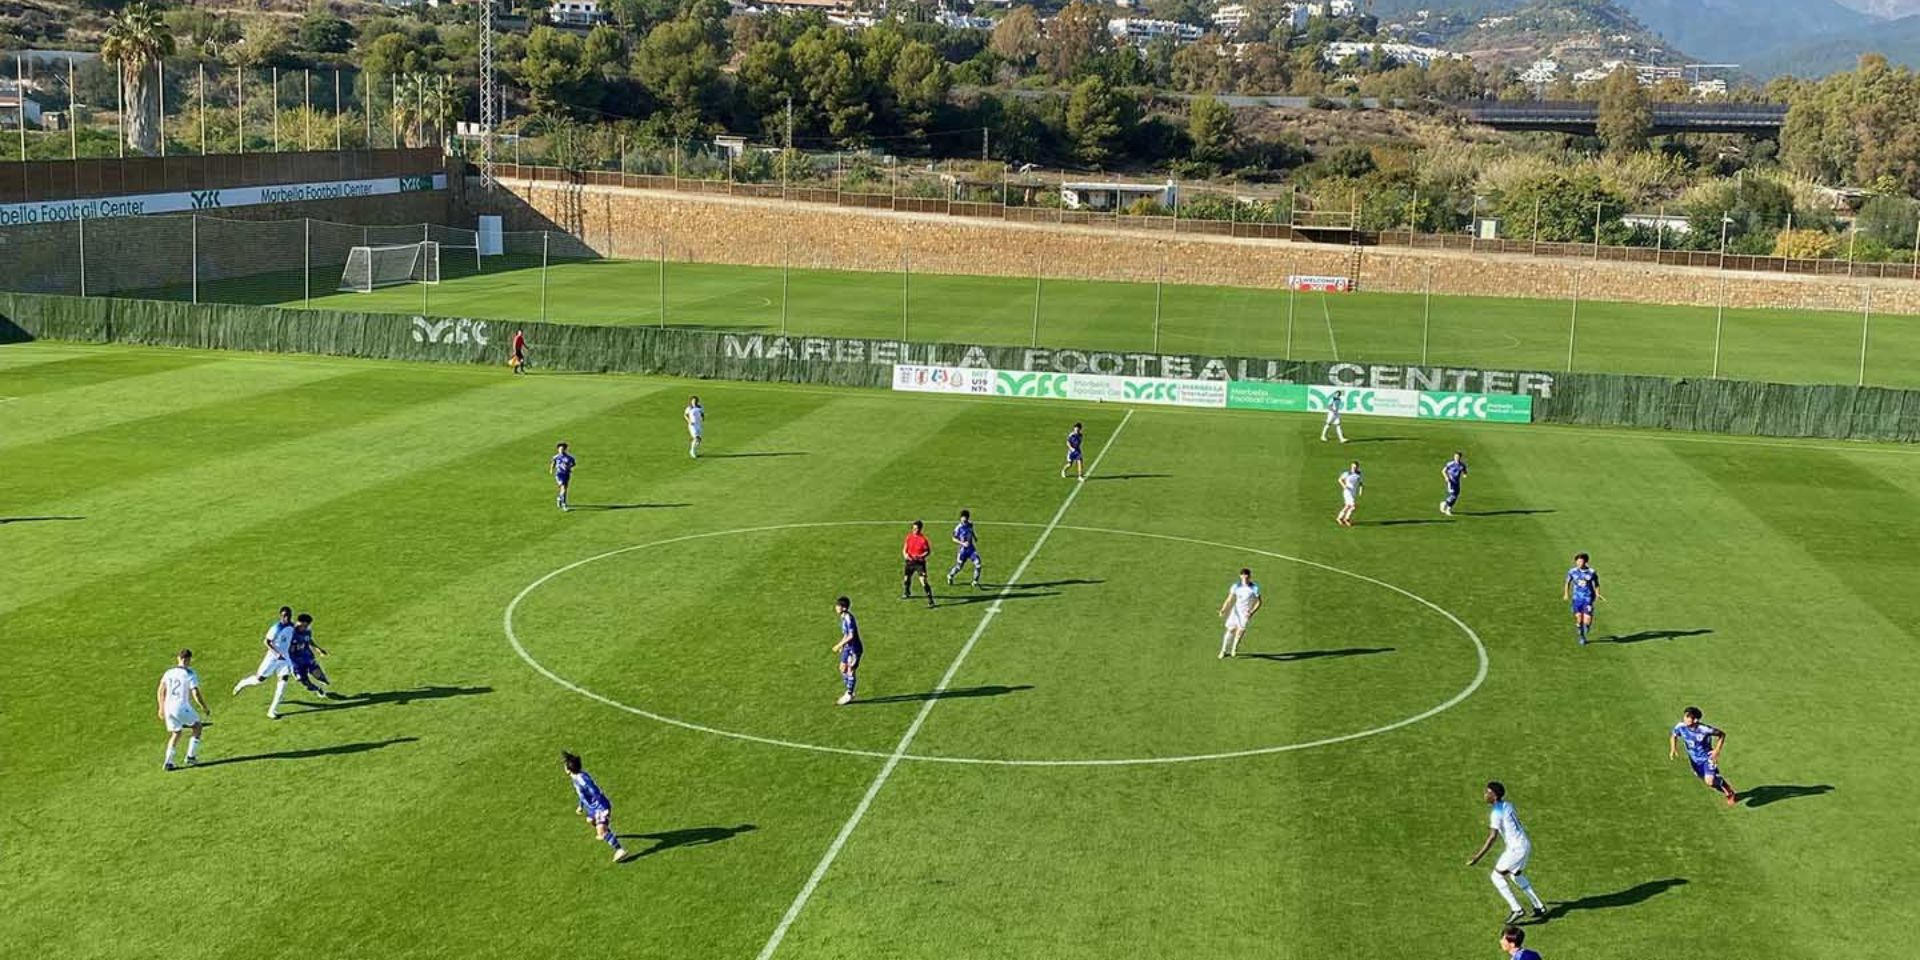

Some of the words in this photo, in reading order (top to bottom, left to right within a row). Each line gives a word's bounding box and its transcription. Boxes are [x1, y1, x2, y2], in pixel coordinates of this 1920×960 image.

[261, 186, 304, 202] Marbella
[306, 184, 341, 199] Football
[344, 183, 373, 196] Center
[41, 201, 97, 220] Football
[100, 200, 145, 217] Center
[724, 335, 992, 369] MARBELLA
[1024, 349, 1294, 384] FOOTBALL
[1329, 363, 1554, 398] CENTER
[169, 678, 181, 696] 12
